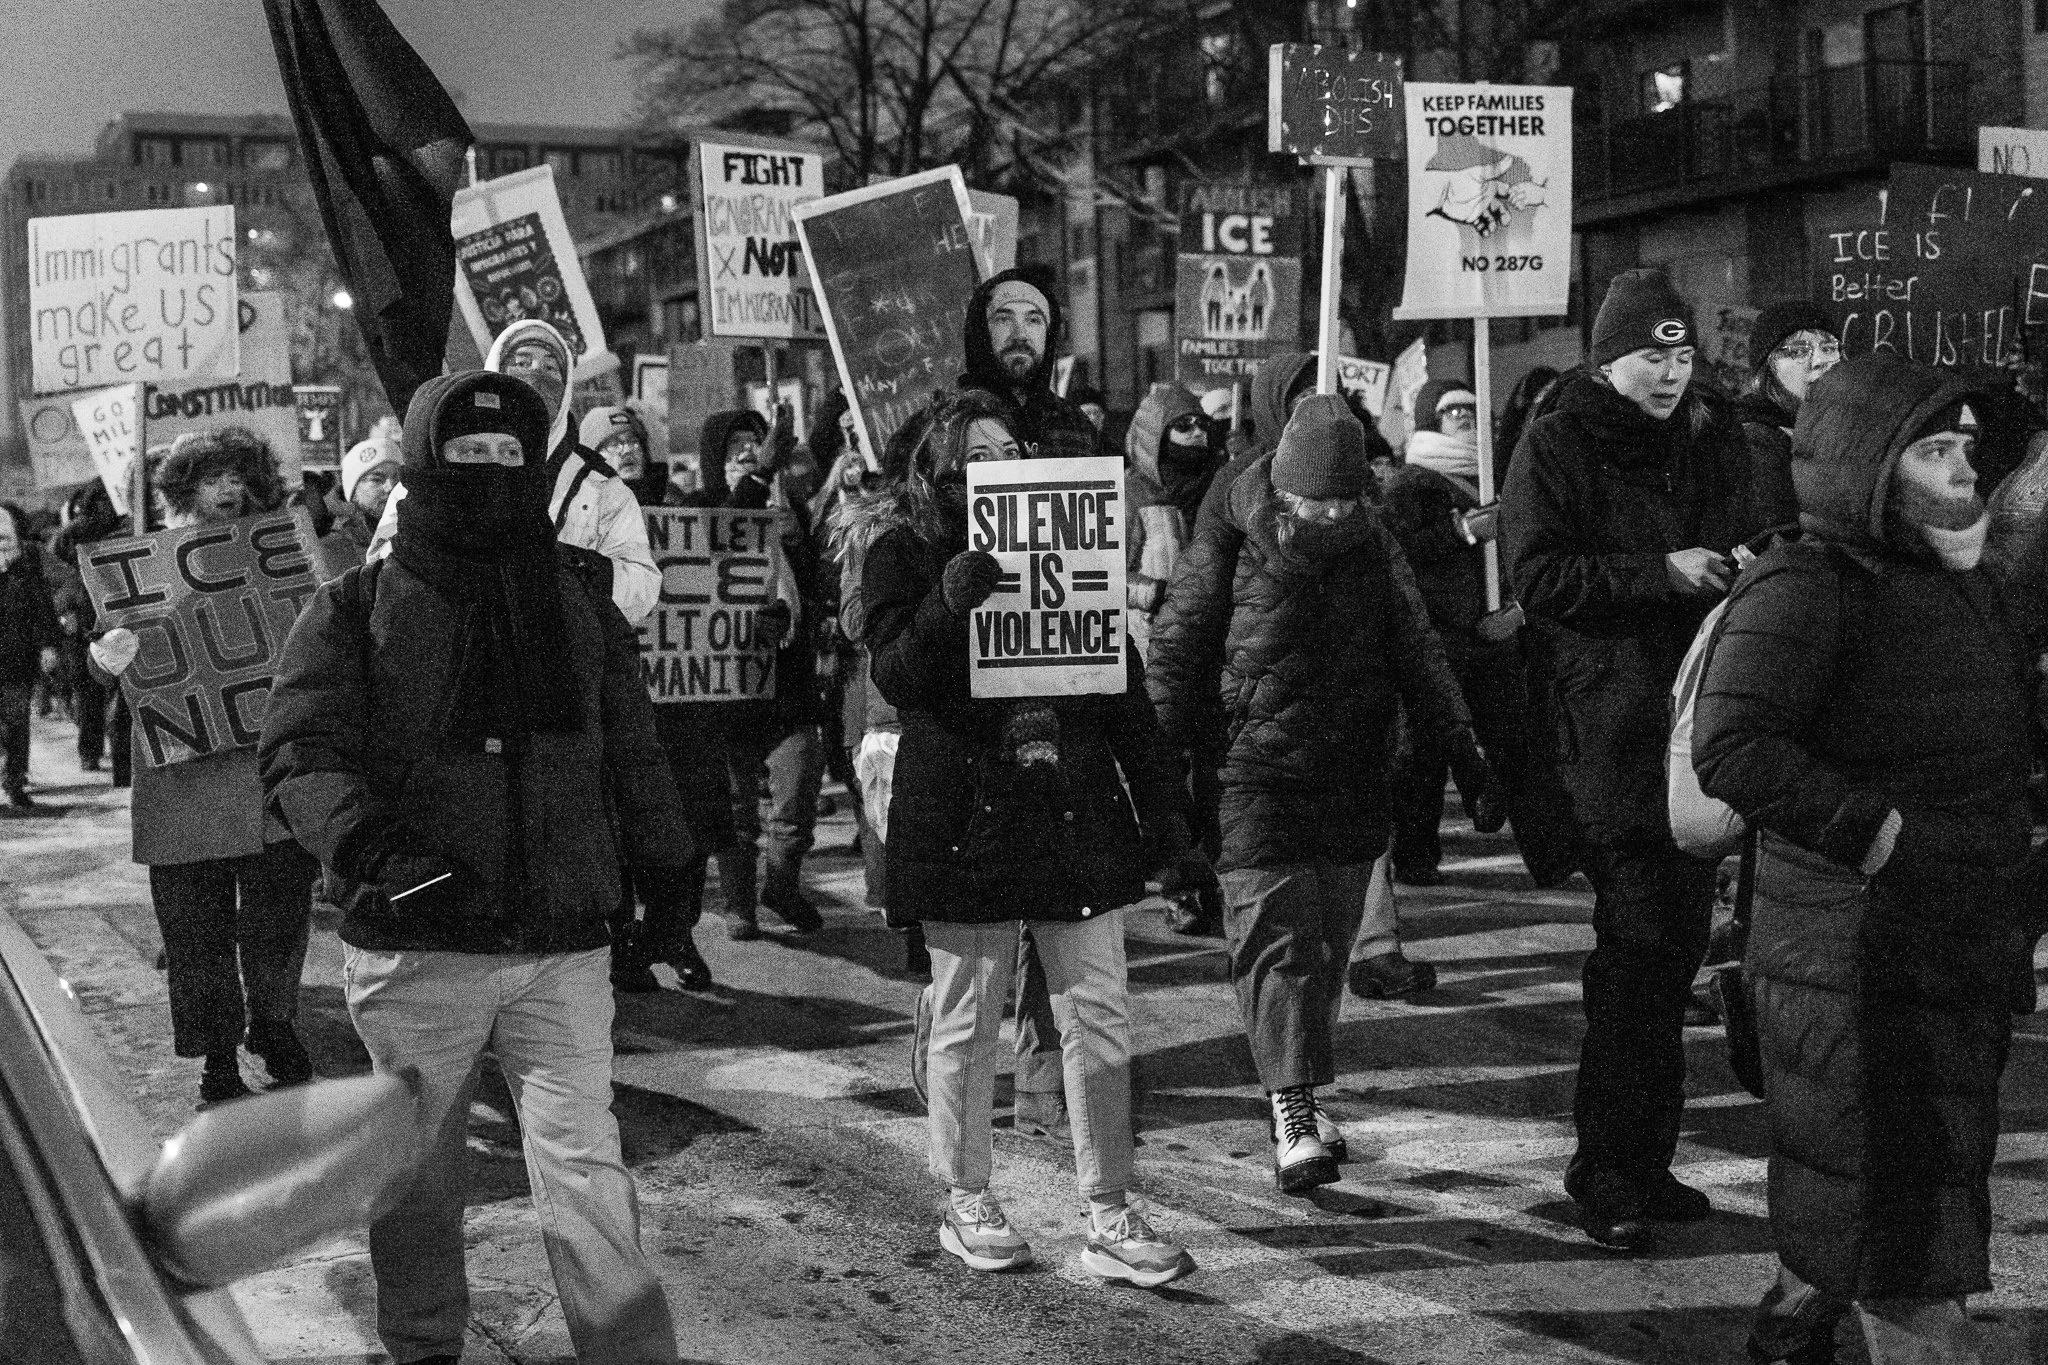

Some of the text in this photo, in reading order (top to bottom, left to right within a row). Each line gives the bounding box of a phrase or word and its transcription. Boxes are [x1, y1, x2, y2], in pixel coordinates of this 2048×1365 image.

[1323, 104, 1373, 136] DHS
[1422, 94, 1545, 112] KEEP FAMILIES
[1425, 115, 1546, 137] TOGETHER
[723, 151, 804, 187] FIGHT
[1201, 212, 1275, 255] ICE
[1829, 230, 1942, 263] ICE IS
[32, 217, 235, 294] Immigrants
[742, 236, 804, 278] NOT
[1461, 254, 1544, 272] NO 287G
[1831, 272, 1919, 302] Better
[36, 288, 146, 341] make
[159, 284, 216, 328] US
[58, 327, 195, 386] great
[1340, 361, 1385, 386] ORT
[650, 514, 774, 553] N'T LET
[972, 491, 1120, 553] SILENCE
[90, 522, 311, 613] ICE
[660, 556, 770, 605] CE
[1029, 552, 1066, 610] IS
[708, 609, 756, 652] OU
[974, 608, 1121, 658] VIOLENCE
[637, 654, 774, 697] MANITY
